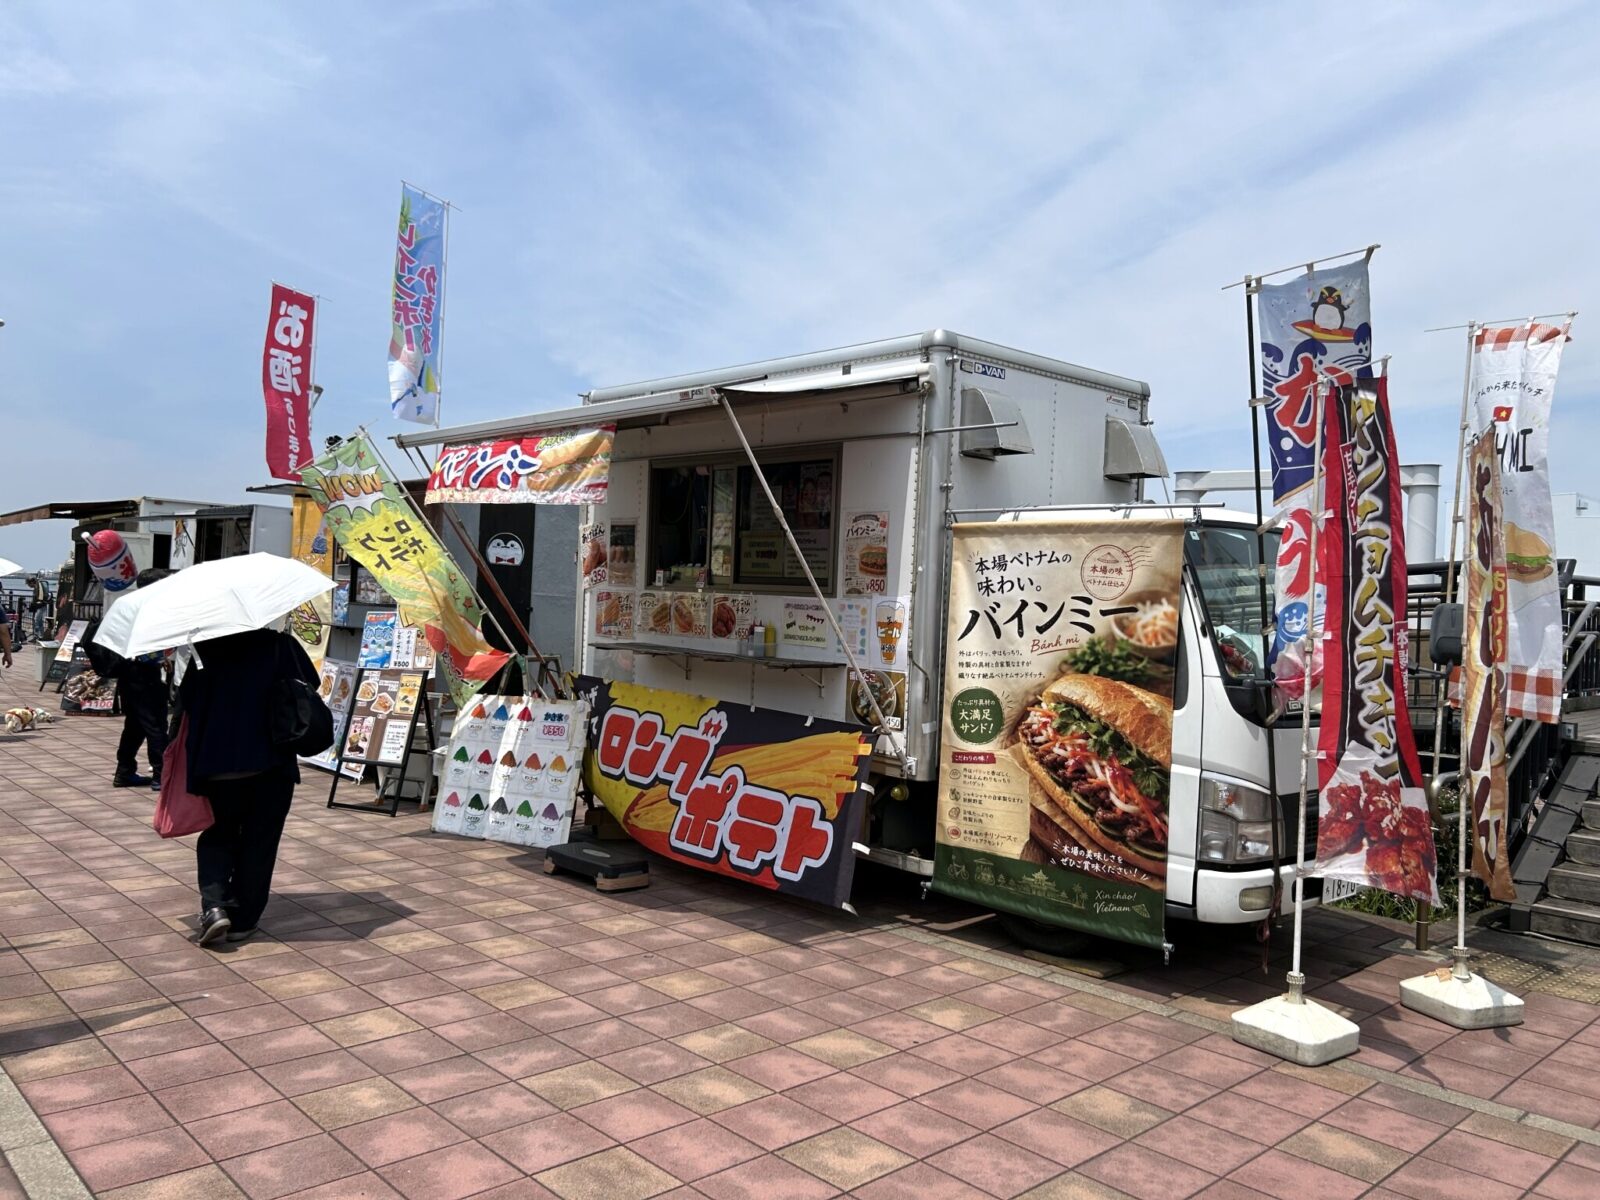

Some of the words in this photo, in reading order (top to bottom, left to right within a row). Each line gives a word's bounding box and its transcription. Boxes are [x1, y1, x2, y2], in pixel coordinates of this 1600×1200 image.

[846, 526, 875, 537] バインミー
[975, 550, 1071, 575] 本場ベトナムの
[1090, 564, 1123, 577] 本場の味
[866, 579, 885, 592] ¥850
[976, 576, 1042, 597] 味わい。
[1086, 579, 1125, 588] ベトナム仕込み
[958, 595, 1139, 641] バインミー
[878, 627, 901, 638] ビール
[959, 709, 992, 721] 大満足
[886, 718, 900, 728] 450
[960, 723, 994, 734] サンド!
[543, 726, 565, 736] ¥350
[600, 711, 725, 798] ロング
[675, 774, 829, 874] ポテト
[1062, 844, 1123, 864] 本場の美味しさを
[1095, 890, 1111, 901] Xin
[1094, 902, 1131, 914] Vietnam
